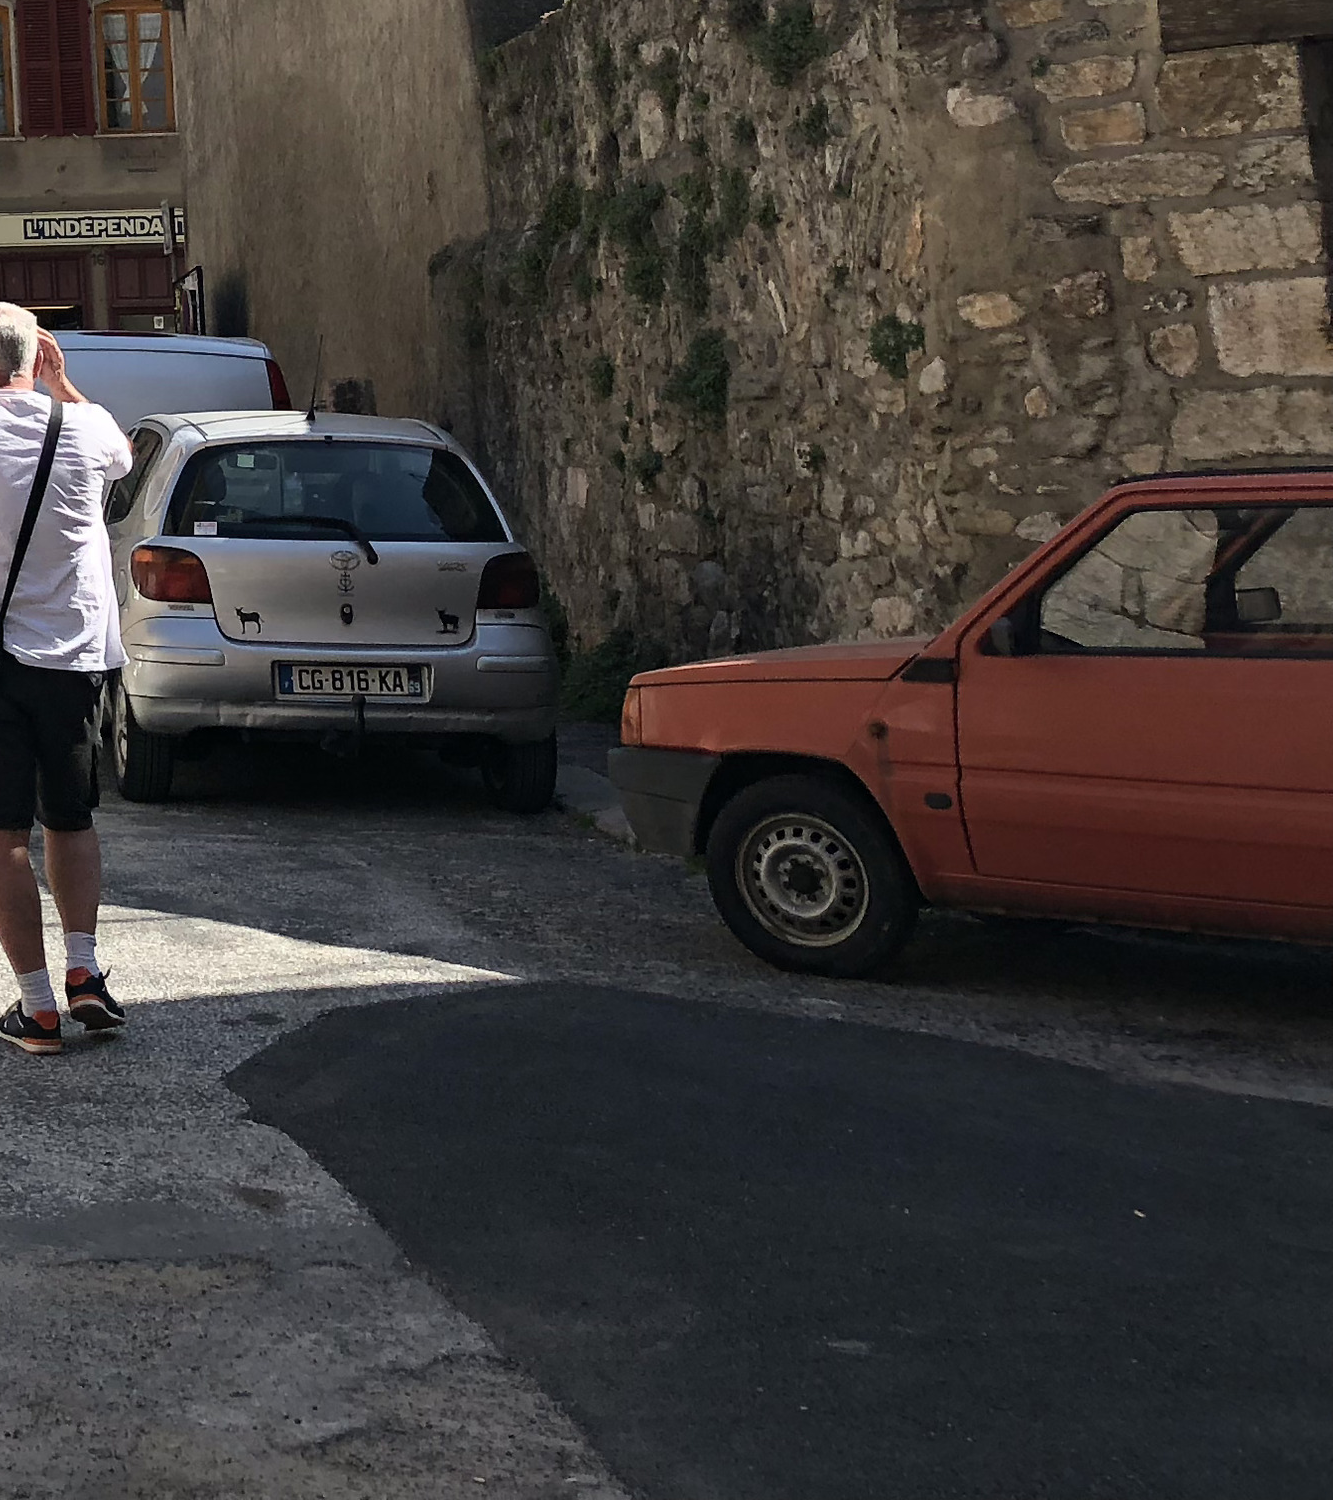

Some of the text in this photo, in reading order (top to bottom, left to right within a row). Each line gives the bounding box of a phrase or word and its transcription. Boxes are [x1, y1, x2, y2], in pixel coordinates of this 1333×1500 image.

[24, 216, 185, 238] L'INDÉPENDA
[91, 253, 105, 266] 16
[298, 668, 405, 693] CG-816-KA
